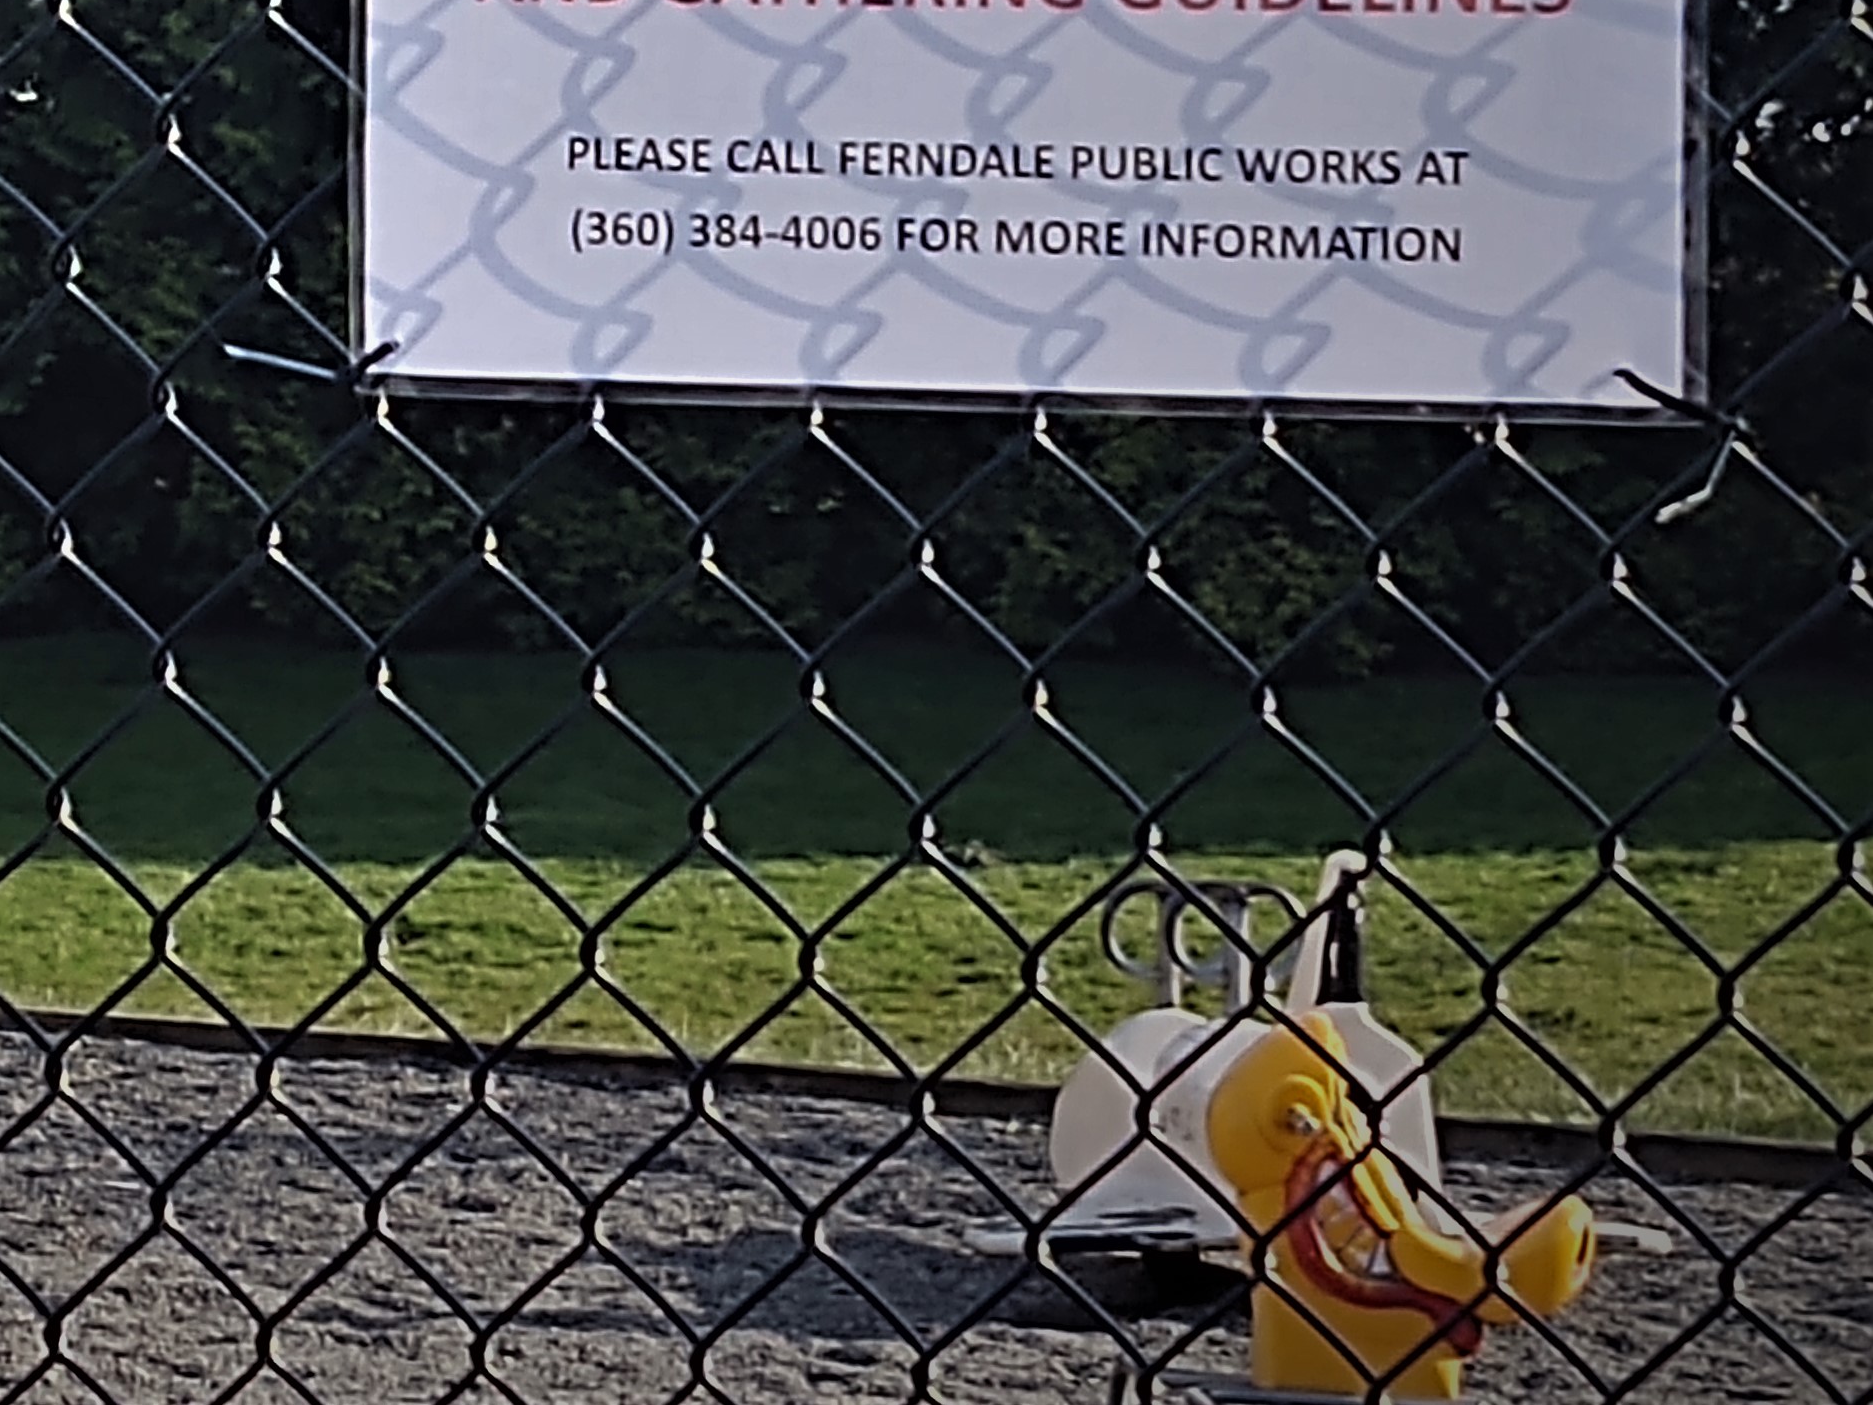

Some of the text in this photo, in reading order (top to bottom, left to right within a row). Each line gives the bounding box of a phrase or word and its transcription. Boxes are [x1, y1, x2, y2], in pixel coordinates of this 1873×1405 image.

[568, 136, 1469, 186] PLEASE CALL FERNDALE PUBLIC WORKS AT
[571, 208, 1462, 263] (360) 384-4006 FOR MORE INFORMATION
